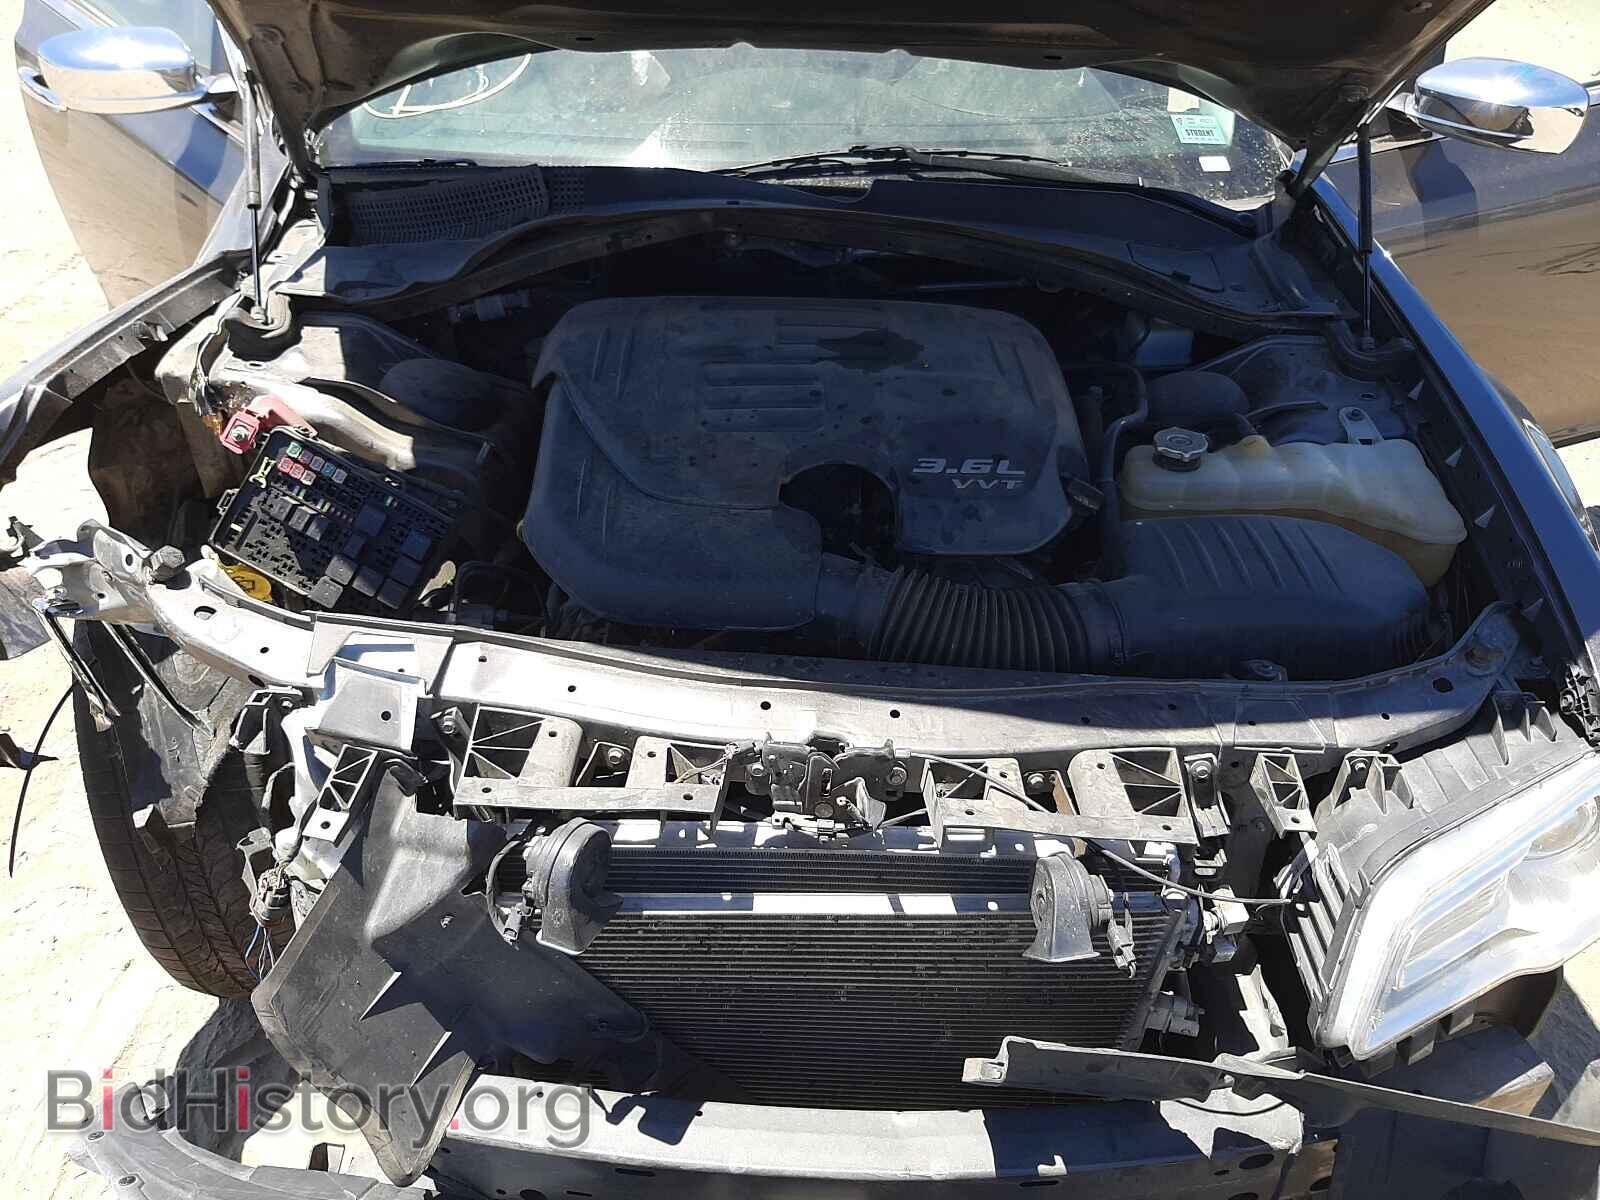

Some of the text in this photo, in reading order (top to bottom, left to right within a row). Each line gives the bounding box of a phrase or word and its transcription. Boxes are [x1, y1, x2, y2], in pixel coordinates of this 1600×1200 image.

[1185, 129, 1215, 137] STUDENT
[912, 457, 1025, 475] 3.6L
[951, 478, 1025, 489] VVT
